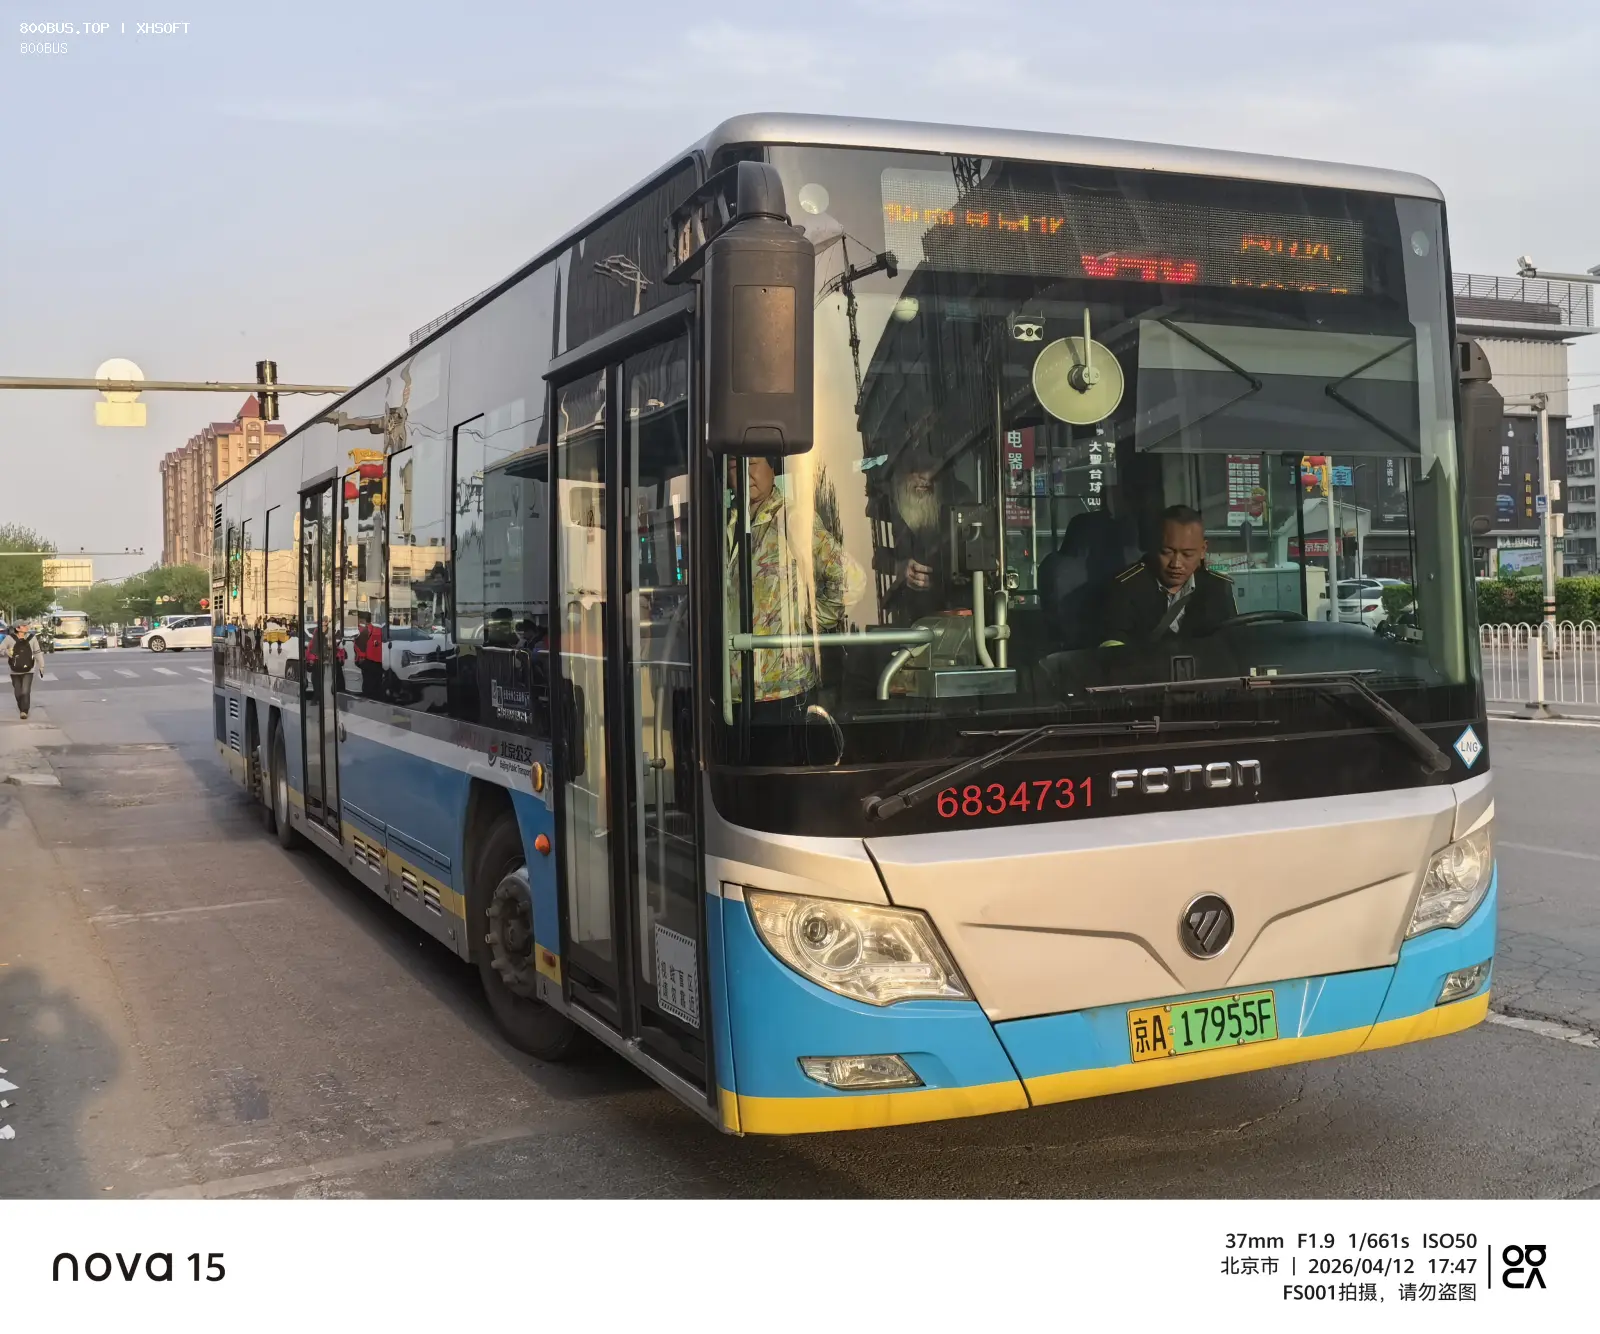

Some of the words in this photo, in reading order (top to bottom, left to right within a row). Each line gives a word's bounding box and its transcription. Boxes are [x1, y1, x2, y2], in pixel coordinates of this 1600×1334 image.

[1007, 429, 1023, 470] 电器
[501, 740, 533, 764] 北京公交
[1460, 741, 1478, 753] LNG
[936, 776, 1093, 818] 6834731
[1110, 758, 1262, 798] FOTON
[1133, 1014, 1167, 1053] 京A
[1180, 998, 1271, 1046] 17955F
